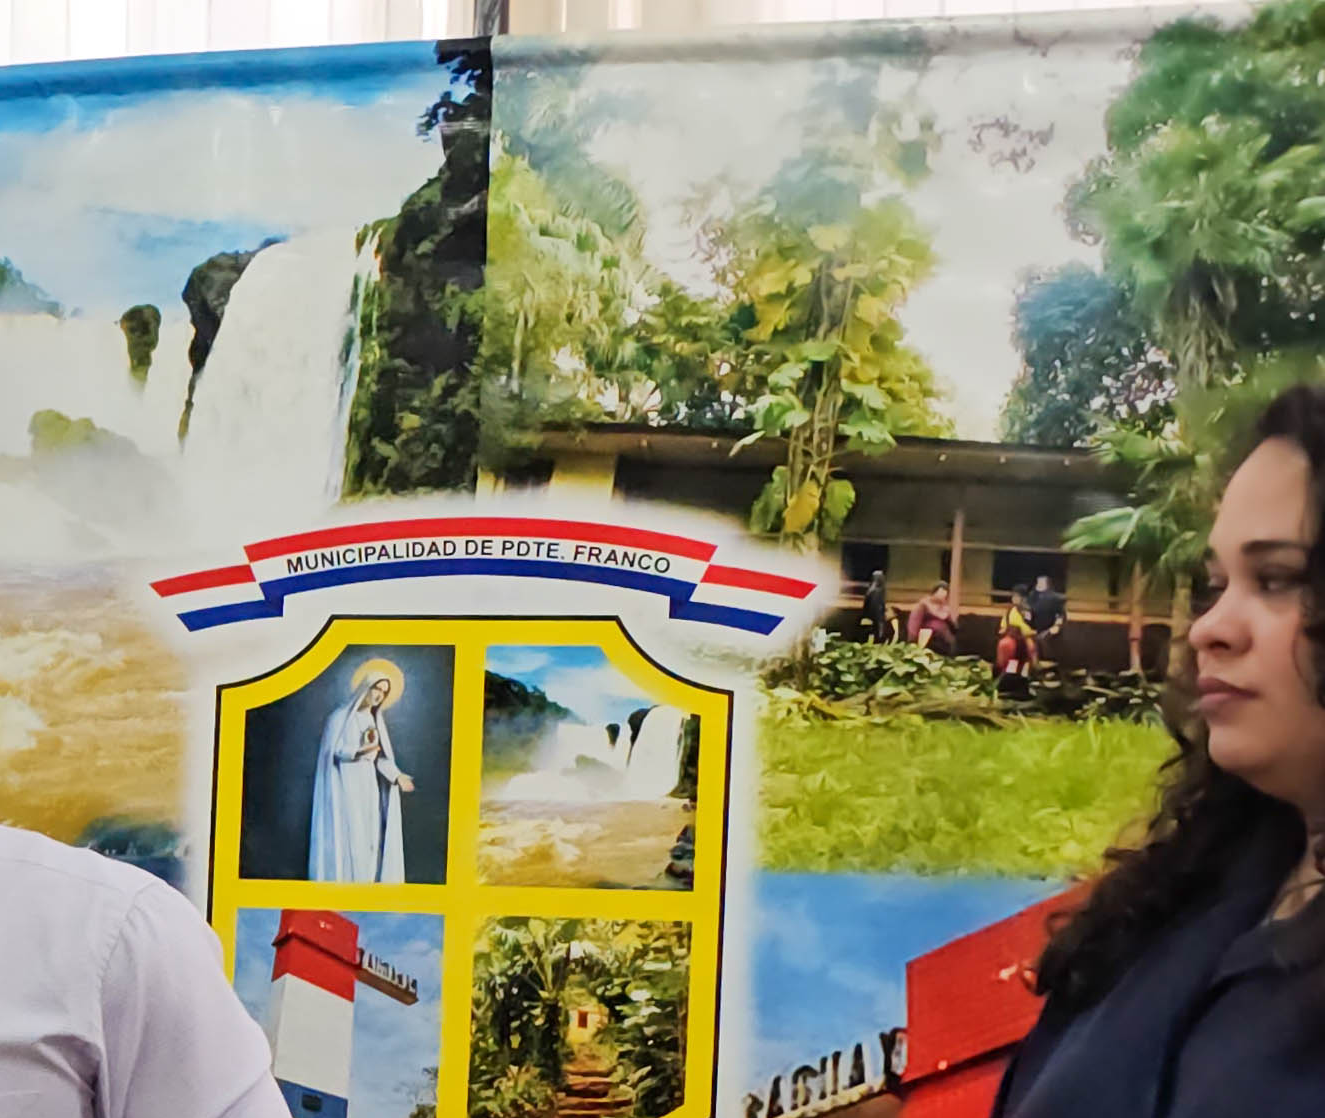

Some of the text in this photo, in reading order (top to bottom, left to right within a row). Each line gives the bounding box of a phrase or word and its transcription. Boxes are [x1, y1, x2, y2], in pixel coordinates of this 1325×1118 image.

[286, 539, 671, 574] MUNICIPALIDAD DE PDTE. FRANCO
